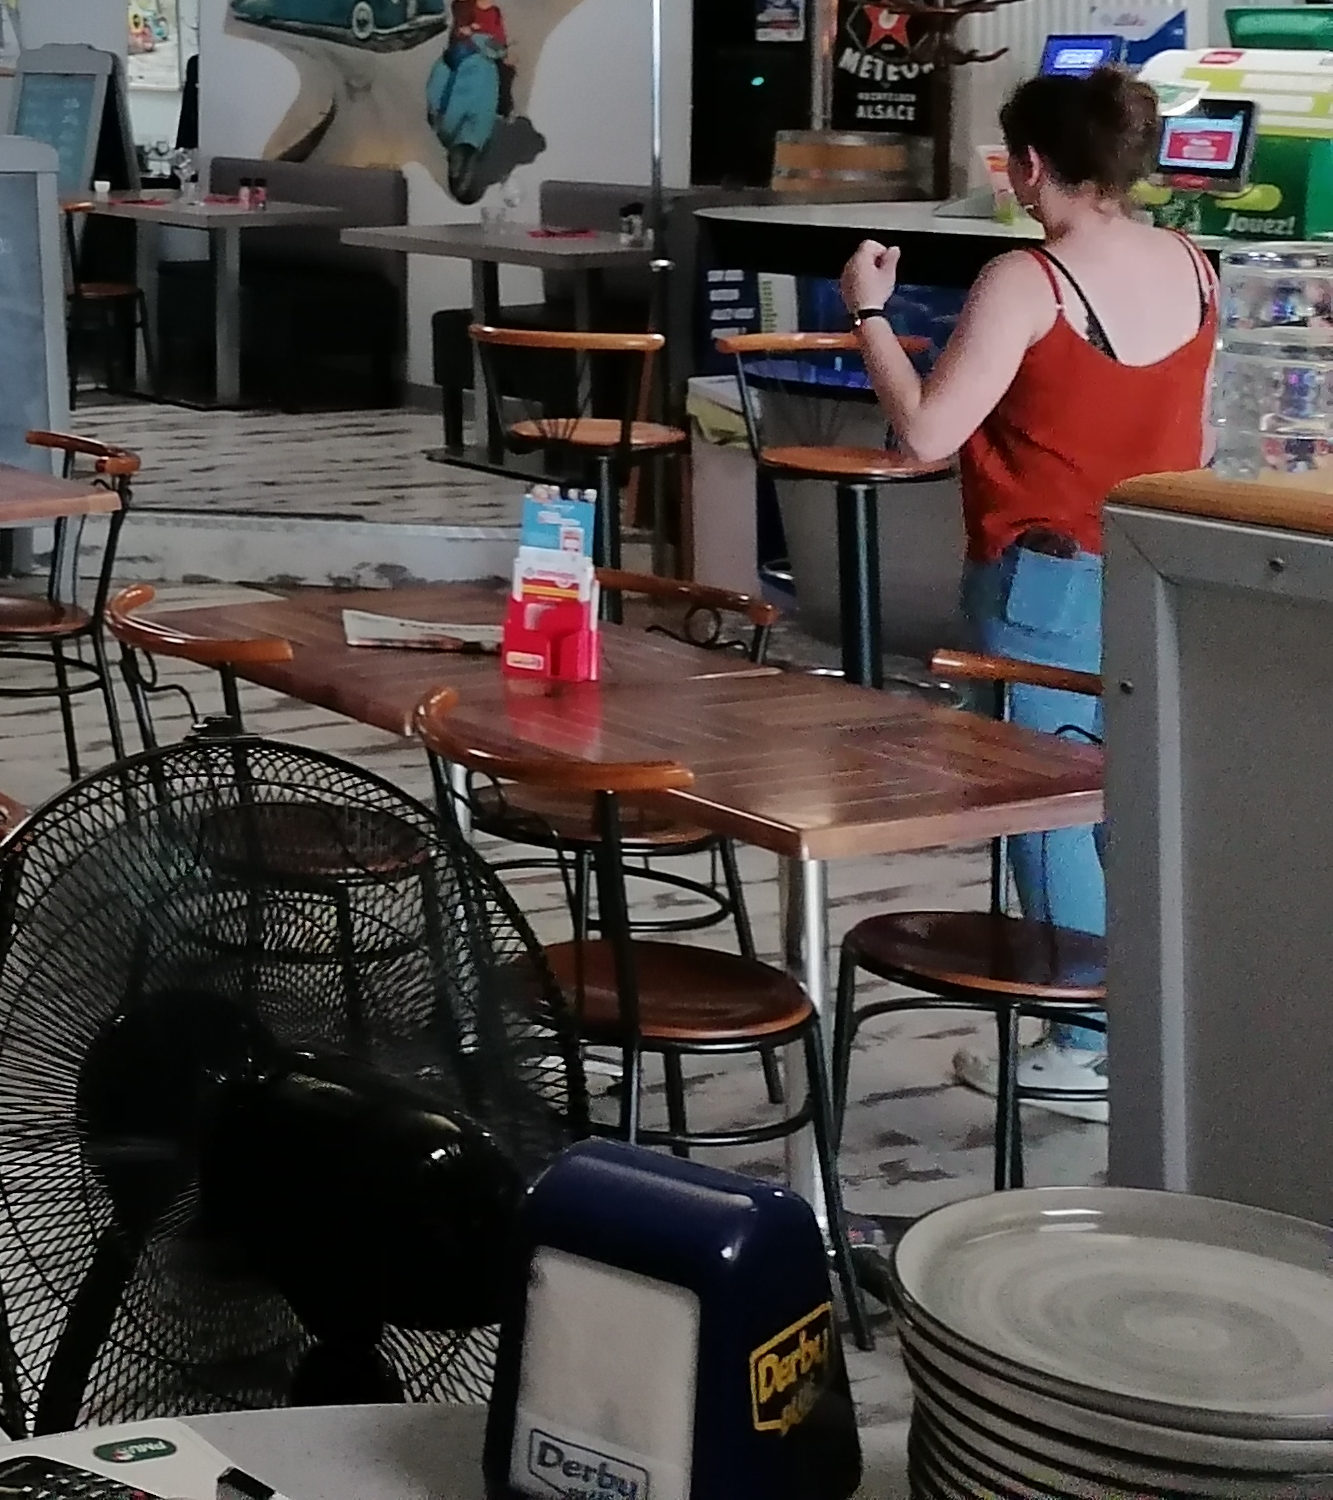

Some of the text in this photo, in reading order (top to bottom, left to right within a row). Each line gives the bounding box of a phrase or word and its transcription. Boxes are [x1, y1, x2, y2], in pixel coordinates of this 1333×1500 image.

[855, 103, 916, 121] ALSACE
[1223, 212, 1296, 236] Jouez!
[536, 1439, 639, 1500] Derby
